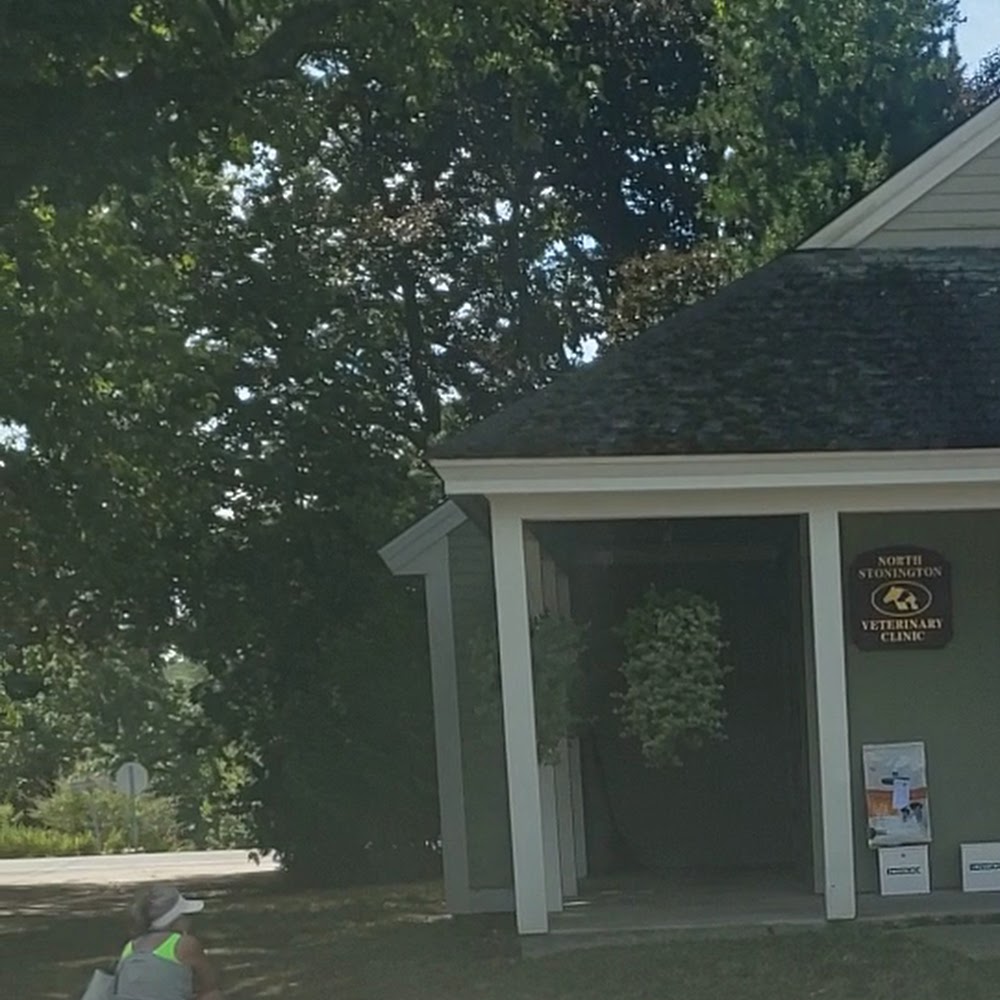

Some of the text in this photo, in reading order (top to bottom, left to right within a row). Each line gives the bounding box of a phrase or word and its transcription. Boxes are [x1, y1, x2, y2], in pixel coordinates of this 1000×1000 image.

[878, 555, 922, 566] NORTH
[859, 567, 942, 579] STONINGTON
[861, 618, 943, 631] VETERINARY
[881, 631, 925, 642] CLINIC
